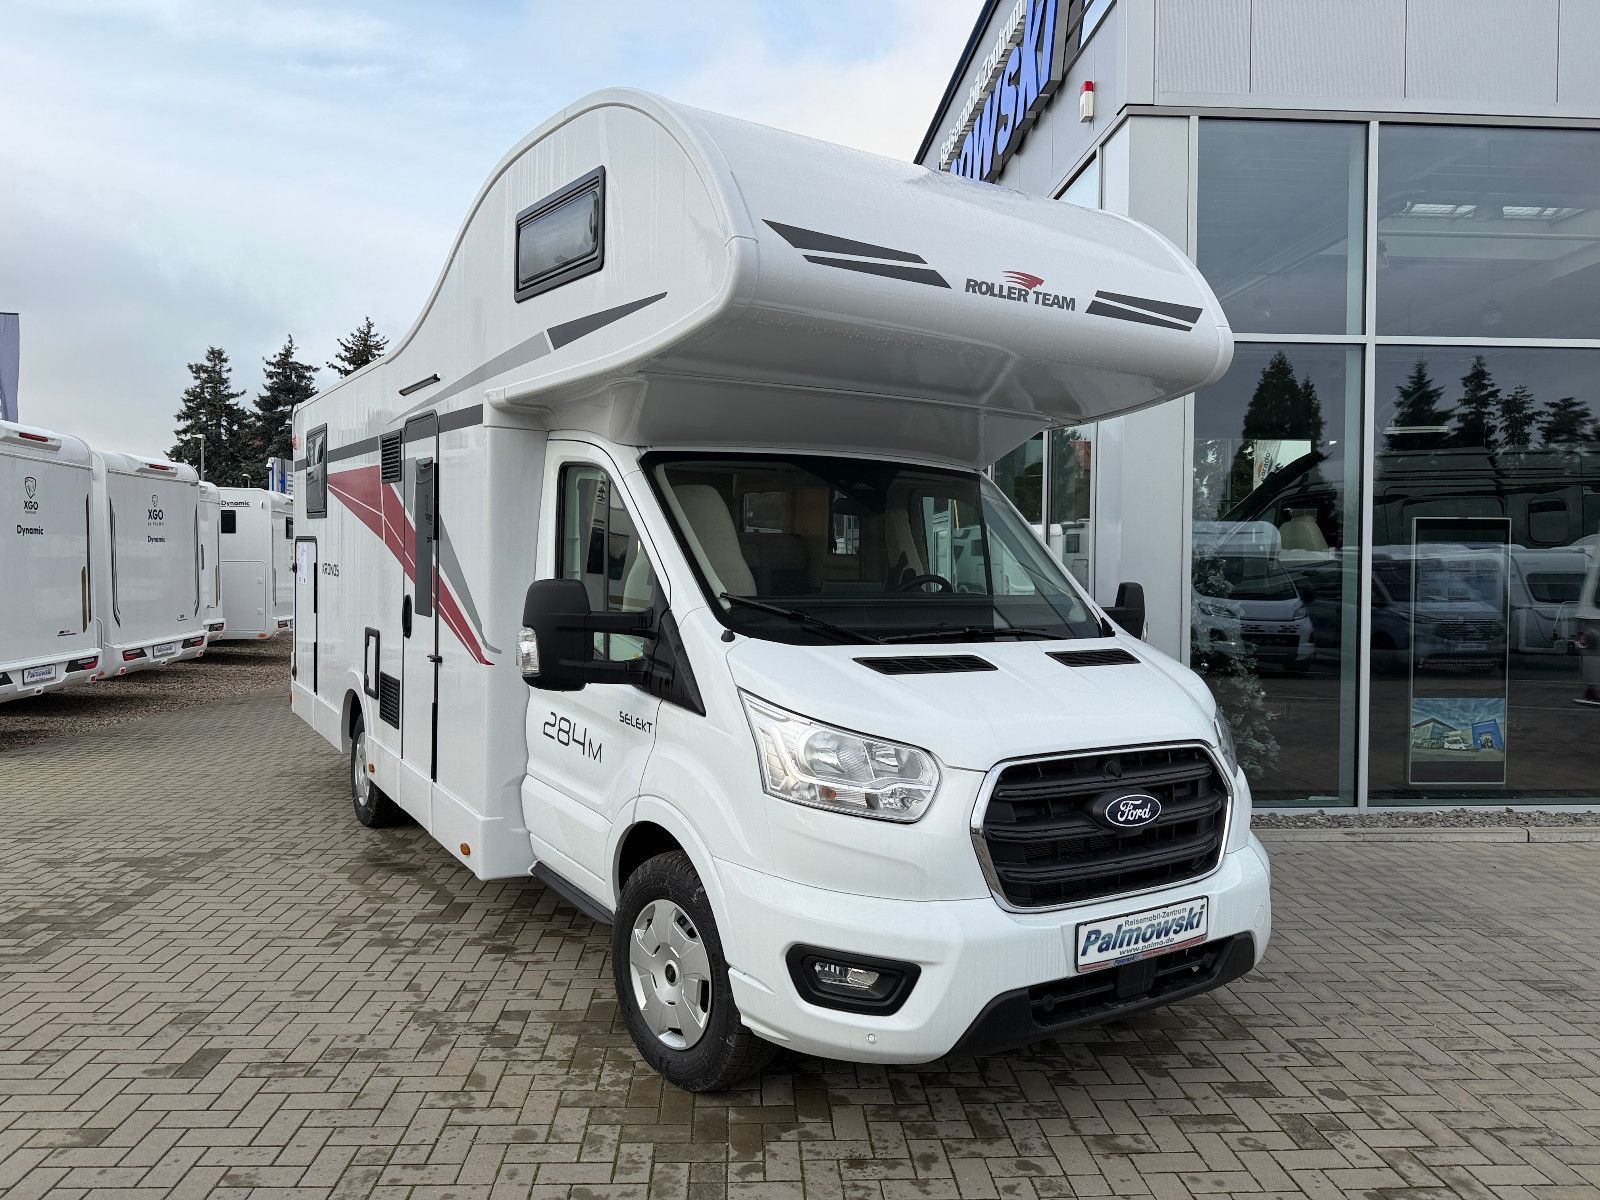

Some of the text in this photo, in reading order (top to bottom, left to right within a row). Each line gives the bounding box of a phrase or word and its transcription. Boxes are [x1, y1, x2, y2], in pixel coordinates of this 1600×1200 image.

[965, 278, 1076, 311] ROLLER TEAM
[24, 500, 39, 510] XGO
[148, 509, 164, 520] XGO
[17, 525, 44, 536] Dynamic
[148, 535, 166, 544] Dynamic
[619, 710, 652, 733] SELEKT
[1117, 799, 1151, 822] Ford
[1124, 907, 1187, 927] Reisemobil-Zentrum
[1081, 904, 1206, 956] Palmowski
[1119, 936, 1175, 956] www.palmo.de
